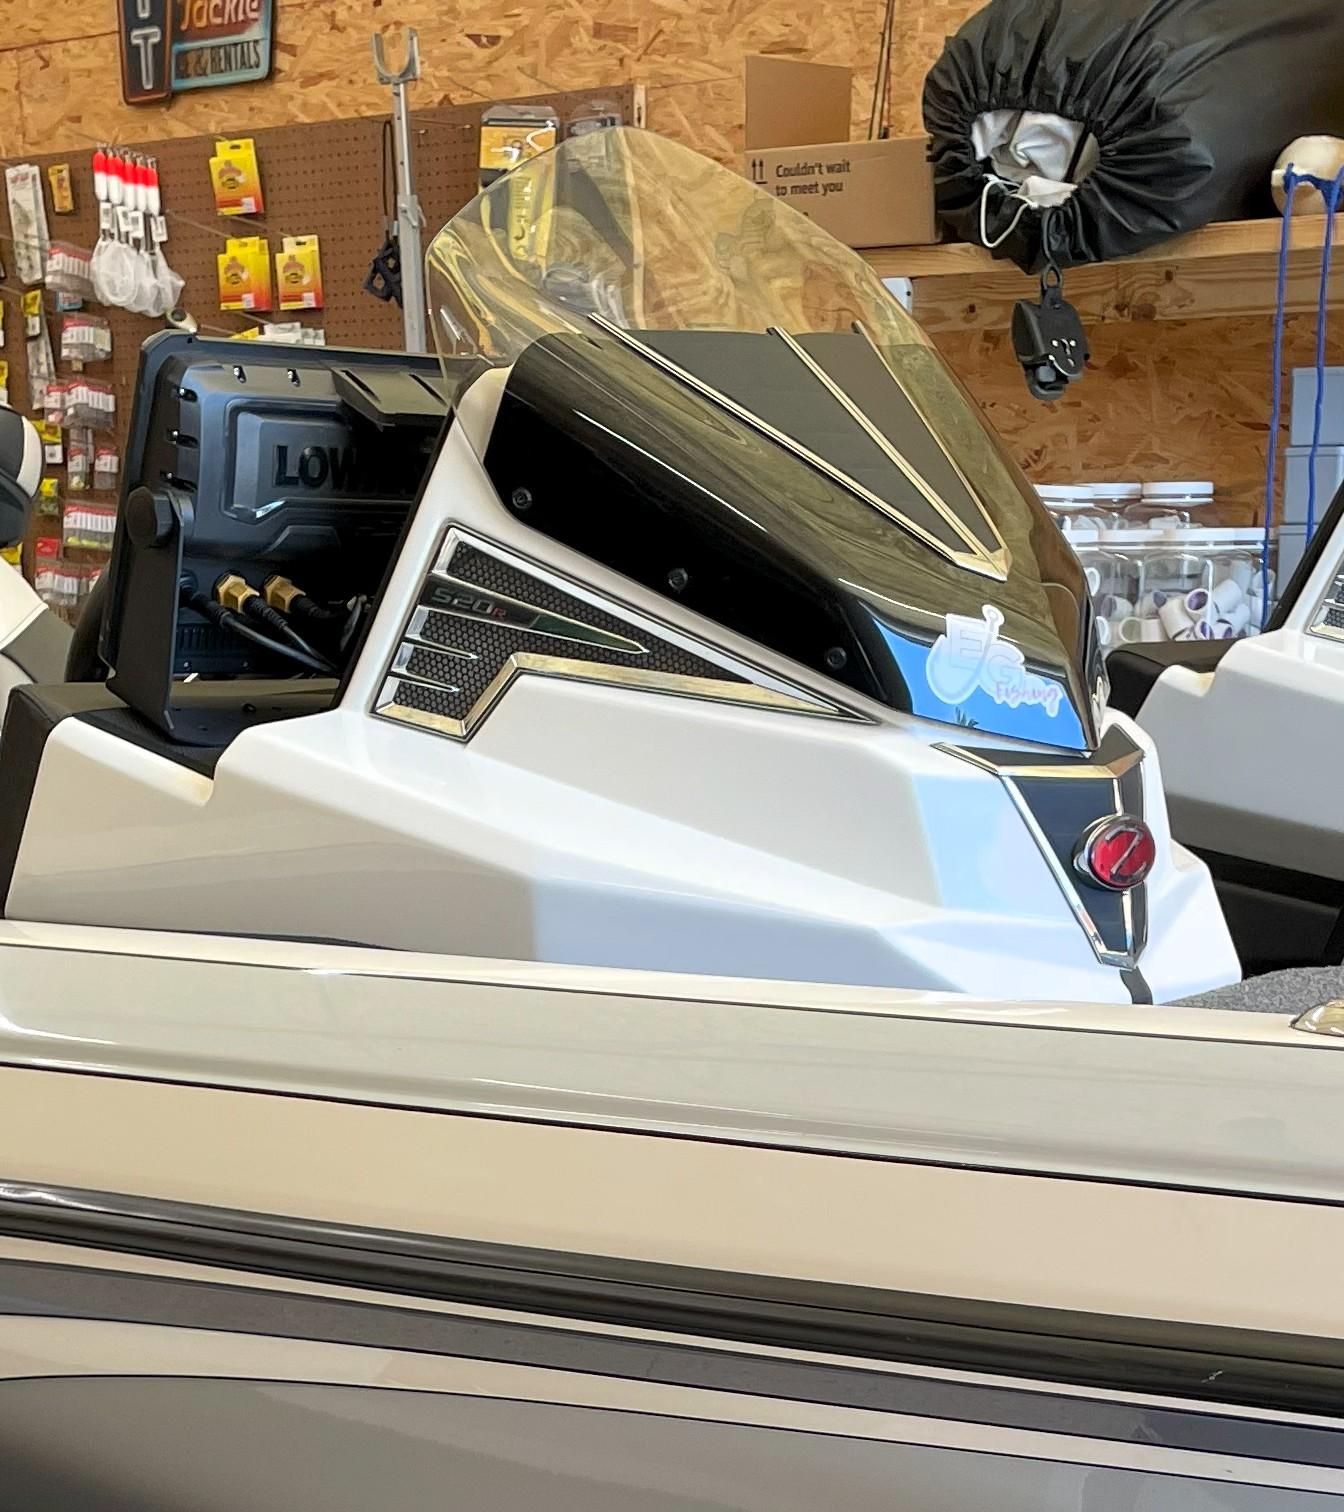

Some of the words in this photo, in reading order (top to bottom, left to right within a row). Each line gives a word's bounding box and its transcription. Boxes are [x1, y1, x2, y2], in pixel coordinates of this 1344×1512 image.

[776, 162, 823, 177] Couldn't
[826, 160, 850, 174] wait
[776, 184, 787, 196] to
[790, 182, 819, 195] meet
[822, 182, 843, 196] you
